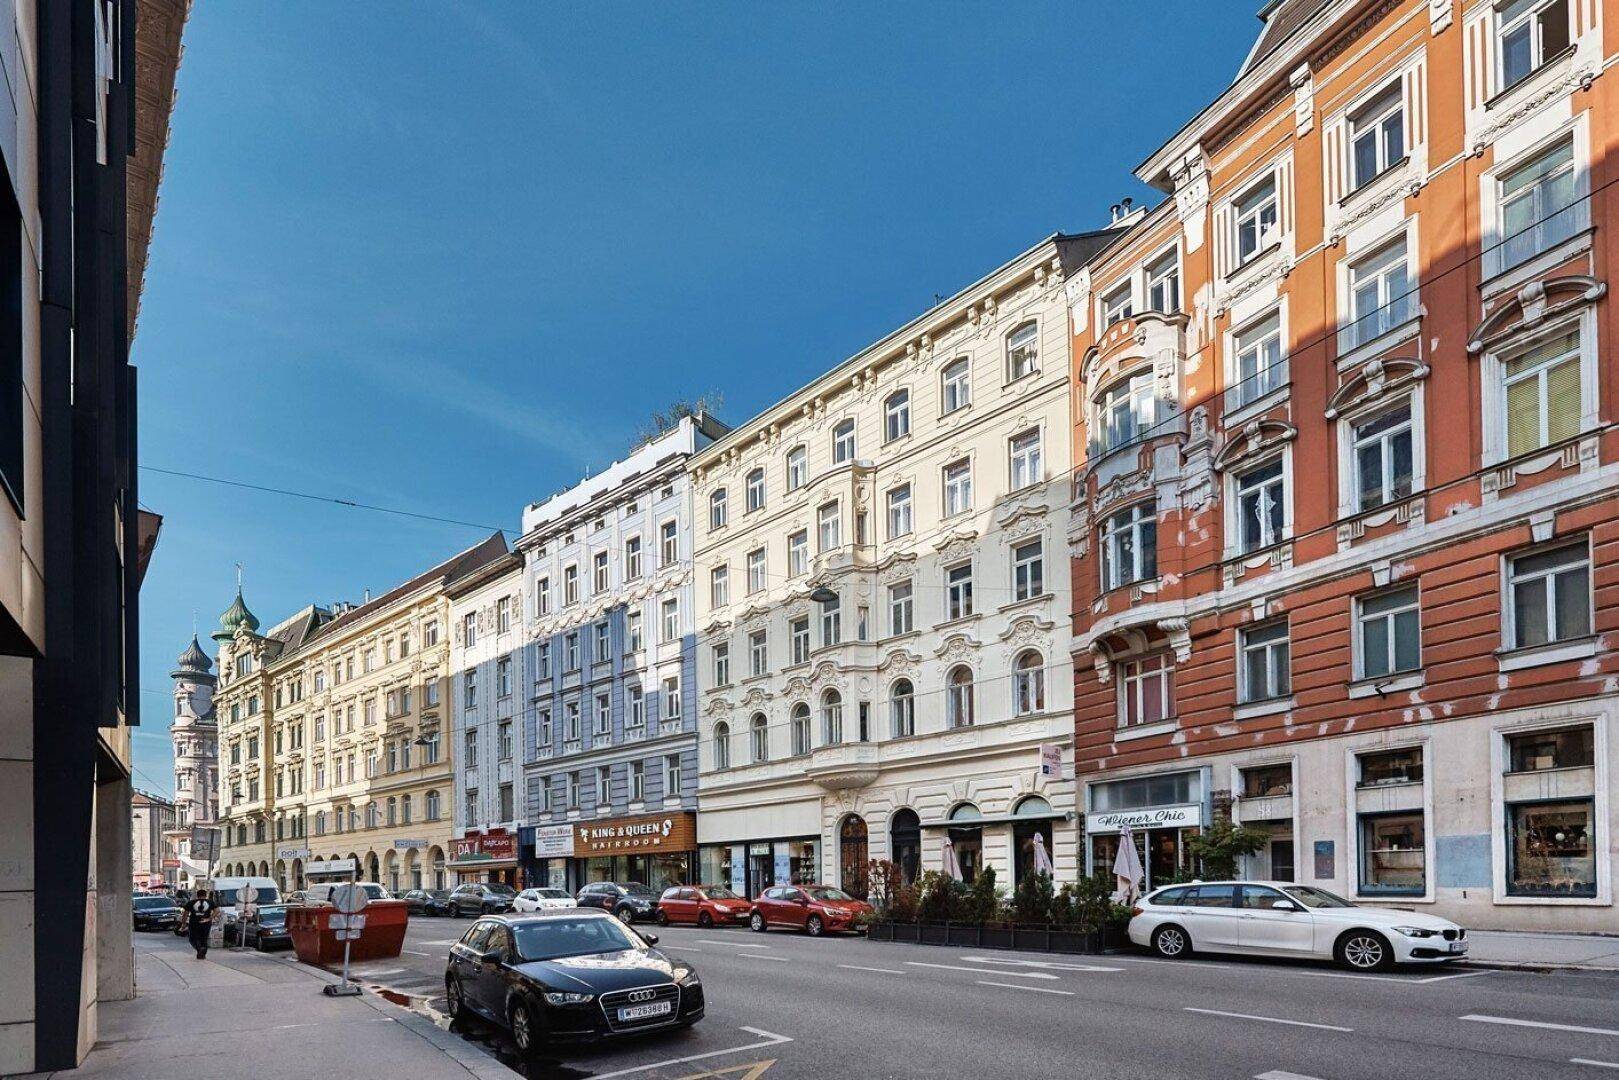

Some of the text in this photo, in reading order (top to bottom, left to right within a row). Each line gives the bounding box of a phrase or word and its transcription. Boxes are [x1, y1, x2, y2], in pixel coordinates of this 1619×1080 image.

[1098, 814, 1152, 826] Wiener
[1152, 810, 1185, 822] Chic
[592, 823, 660, 838] KING & QUEEN
[592, 837, 660, 850] HAIRROOM
